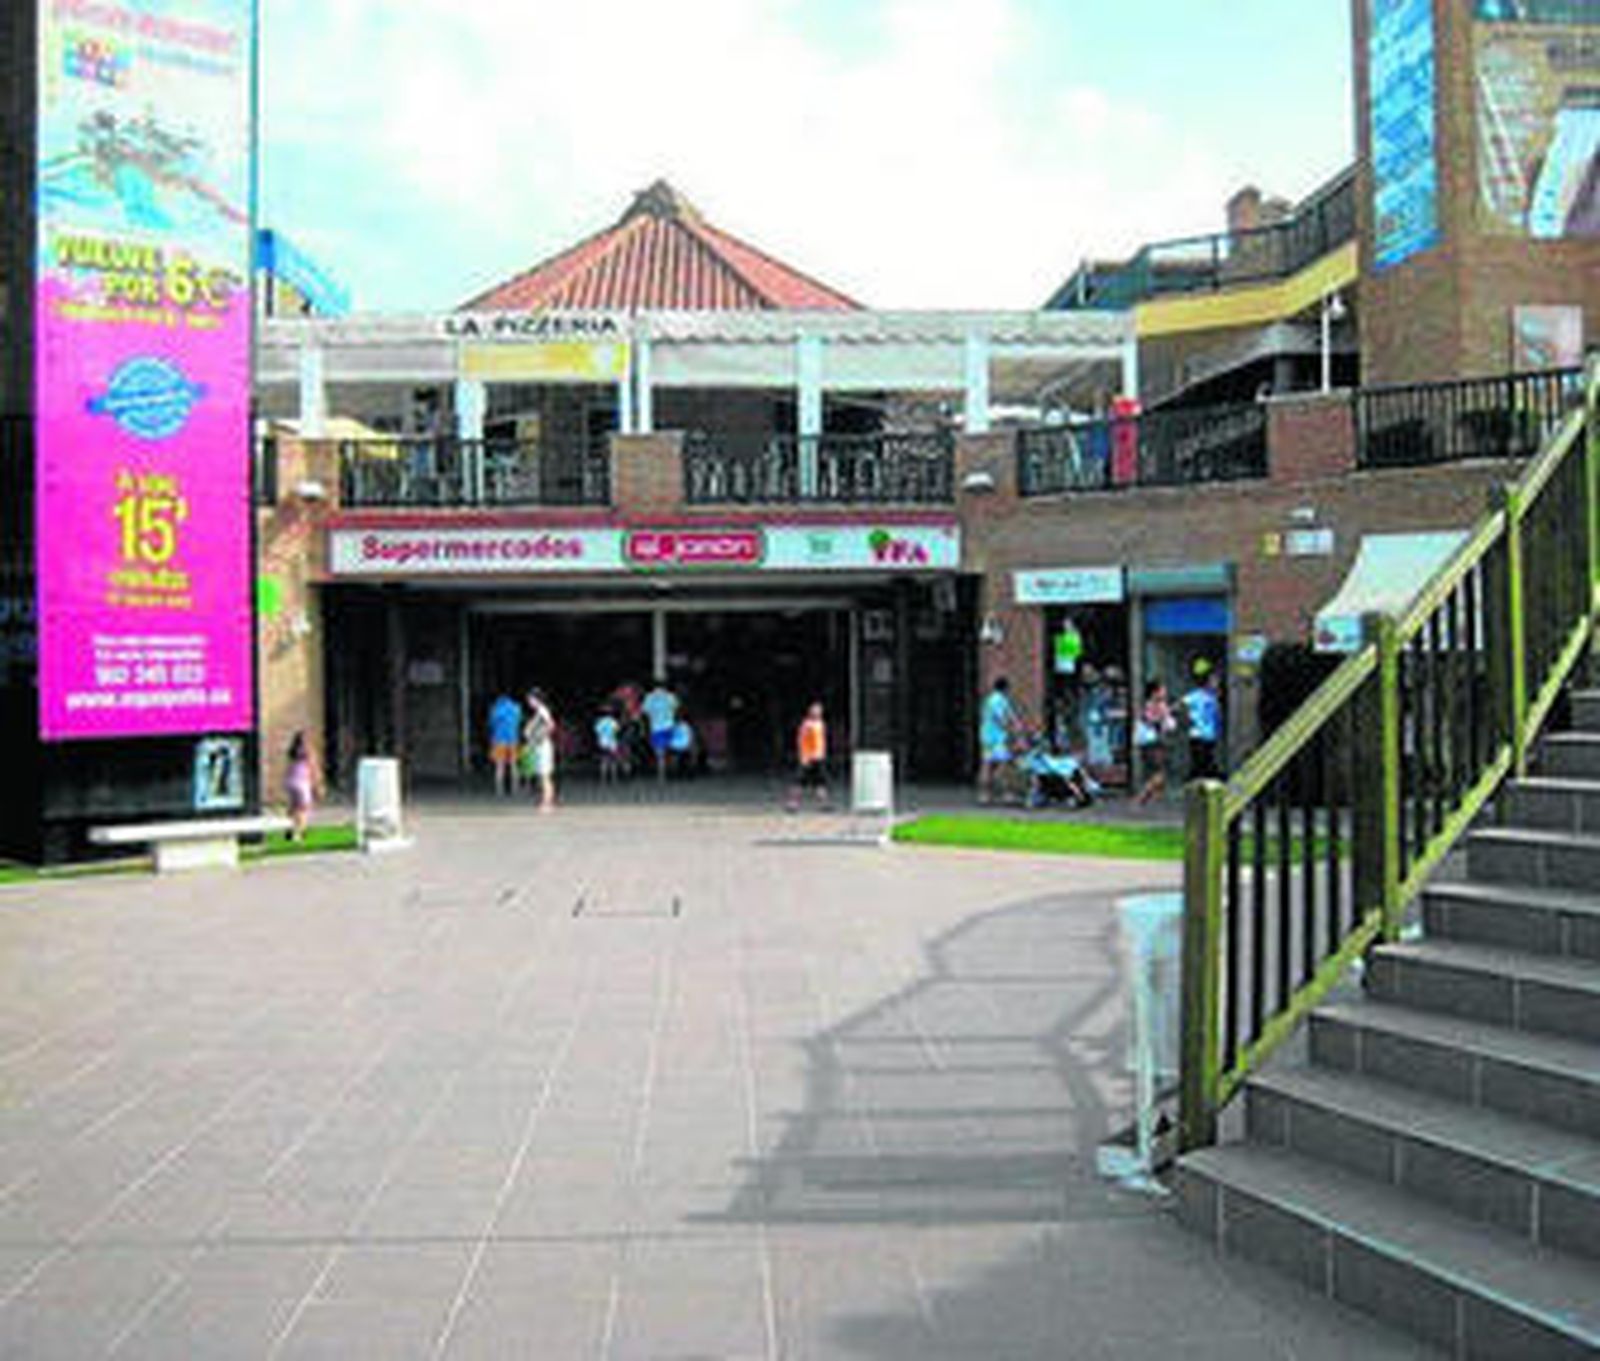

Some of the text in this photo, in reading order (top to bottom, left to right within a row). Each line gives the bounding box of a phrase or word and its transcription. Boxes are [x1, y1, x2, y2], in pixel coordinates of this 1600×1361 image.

[444, 315, 619, 336] LA PIZZERIA
[362, 534, 584, 564] Supermercados
